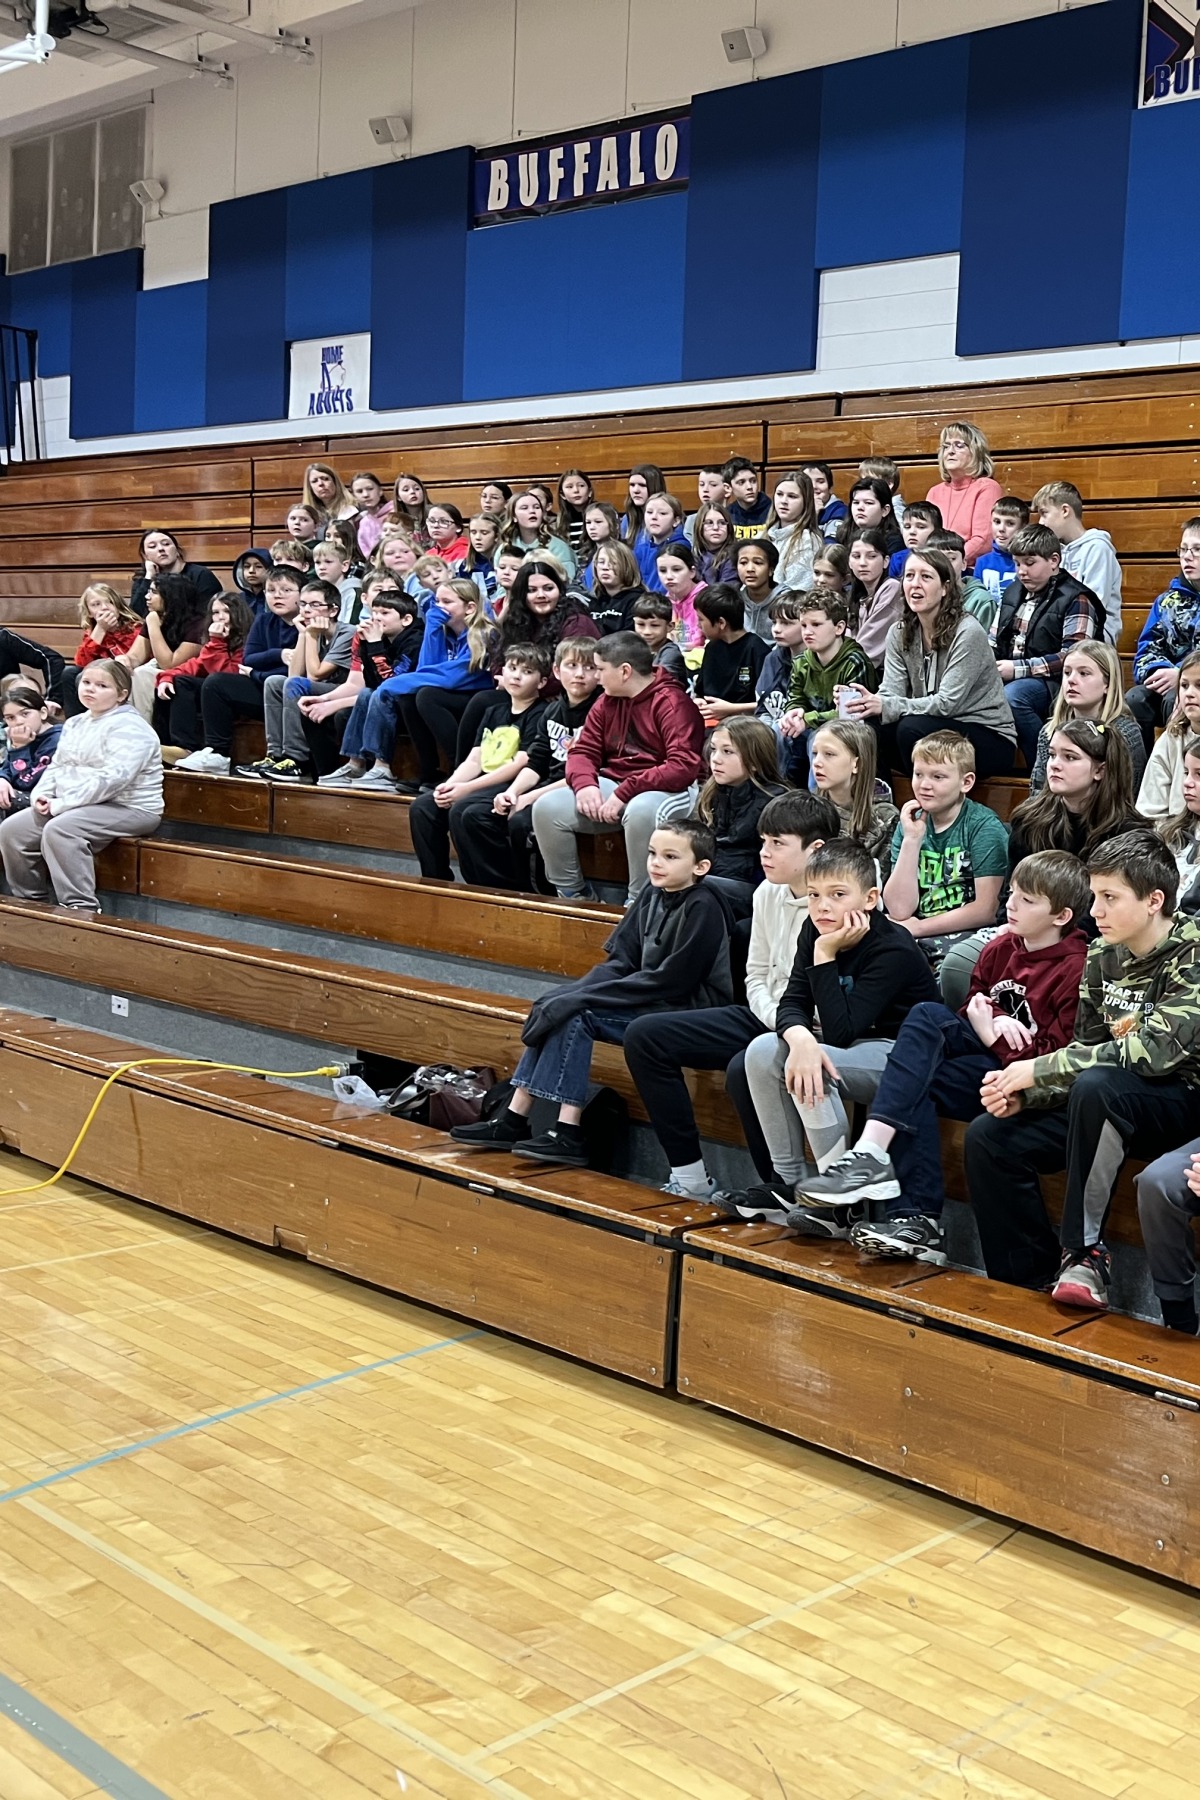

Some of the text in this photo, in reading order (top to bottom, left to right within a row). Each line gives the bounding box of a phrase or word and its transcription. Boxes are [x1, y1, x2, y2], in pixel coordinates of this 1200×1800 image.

[487, 124, 679, 211] BUFFALO
[308, 388, 354, 416] ADULTS
[1102, 980, 1146, 1002] TRAP TE
[1104, 994, 1142, 1013] UPDAT
